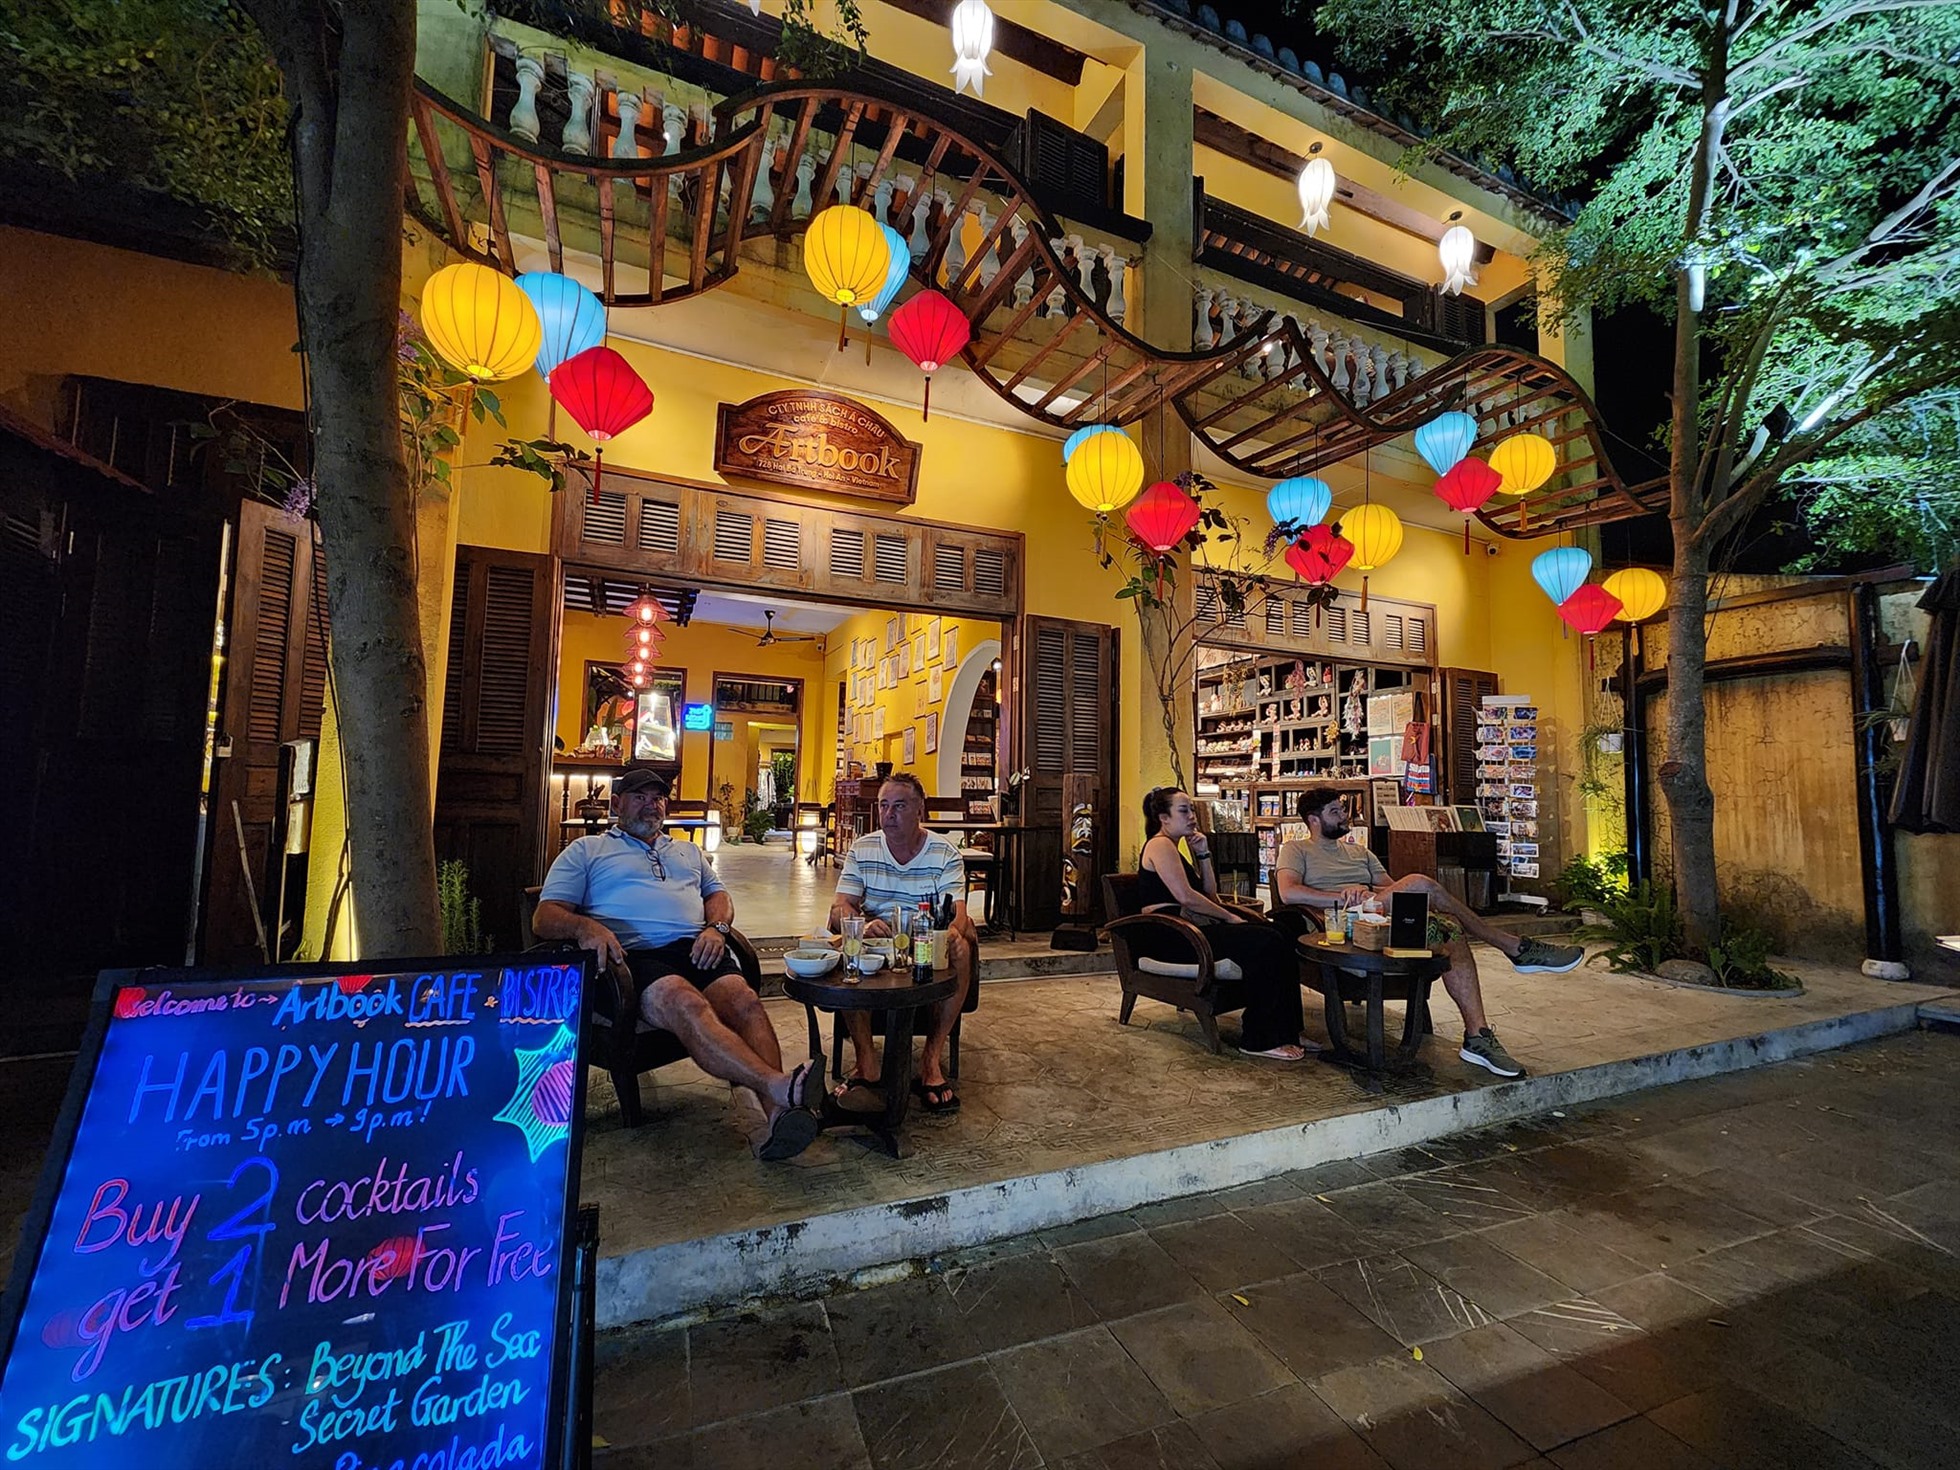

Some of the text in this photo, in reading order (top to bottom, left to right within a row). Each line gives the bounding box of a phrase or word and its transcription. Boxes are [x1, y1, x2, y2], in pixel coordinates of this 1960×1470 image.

[768, 404, 788, 415] CTY
[789, 402, 817, 412] TNHH
[819, 402, 848, 419] SÁCH
[830, 415, 859, 434] bistro
[738, 422, 901, 480] Artbook
[773, 462, 785, 473] Hai
[836, 473, 846, 483] An
[852, 475, 880, 489] Vietnam
[116, 990, 228, 1019] Welcome
[231, 986, 256, 1009] to
[271, 977, 404, 1027] Artbook
[408, 973, 482, 1022] CAFE
[501, 968, 580, 1019] BISTRO
[128, 1035, 475, 1124] HAPPY HOUR
[175, 1128, 231, 1152] From
[241, 1117, 312, 1152] 5p.m
[73, 1152, 479, 1275] Buy 2 cocktails
[71, 1210, 553, 1383] get 1 More For Free
[305, 1341, 427, 1408] Beyond
[433, 1321, 479, 1375] The
[491, 1312, 541, 1360] Sea
[291, 1374, 531, 1454] Secret Garden
